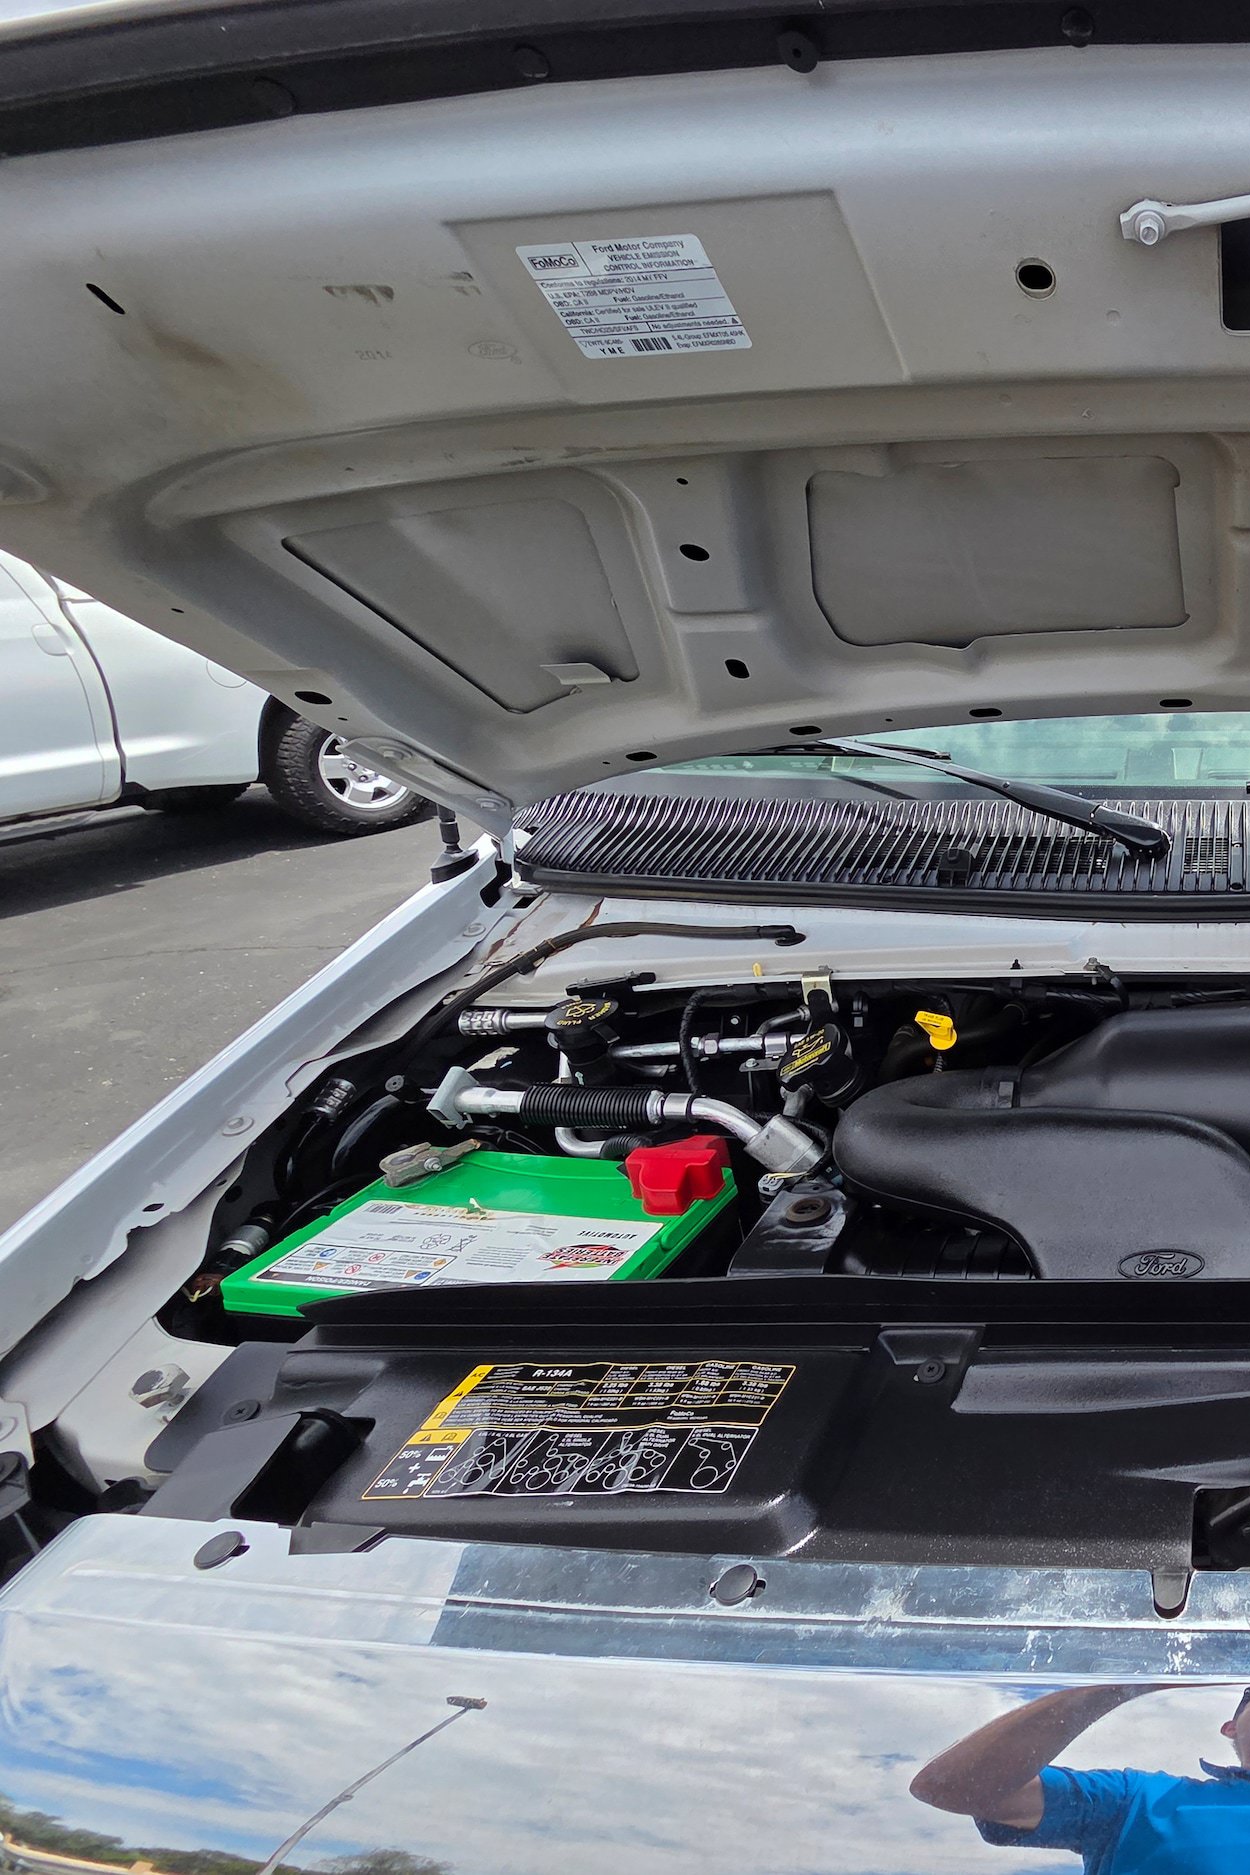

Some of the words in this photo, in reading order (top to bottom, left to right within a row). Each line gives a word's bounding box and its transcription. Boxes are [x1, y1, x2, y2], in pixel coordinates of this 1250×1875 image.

[592, 243, 614, 253] Ford
[614, 242, 641, 251] Motor
[641, 239, 684, 250] Company
[530, 256, 576, 269] FoMoCo
[607, 253, 641, 262] VEHICLE
[641, 250, 680, 260] EMISSION
[603, 262, 641, 272] CONTROL
[642, 259, 695, 270] INFORMATION
[540, 280, 575, 289] Conforms
[624, 275, 643, 283] 2014
[653, 272, 669, 280] FFV
[613, 295, 632, 304] Fuel:
[632, 291, 686, 302] Gasoline/Ethanol
[560, 309, 595, 319] California:
[595, 306, 622, 316] Certified
[671, 301, 699, 311] qualified
[624, 313, 643, 321] Fuel:
[643, 310, 697, 320] Gasoline/Ethanol
[663, 320, 701, 332] adjustments
[702, 317, 730, 326] needed.
[577, 1230, 637, 1240] AUTOMOTIVE
[1134, 1252, 1188, 1276] Ford
[531, 1369, 573, 1378] R-134A
[399, 1450, 422, 1459] 50%
[374, 1479, 399, 1488] 50%
